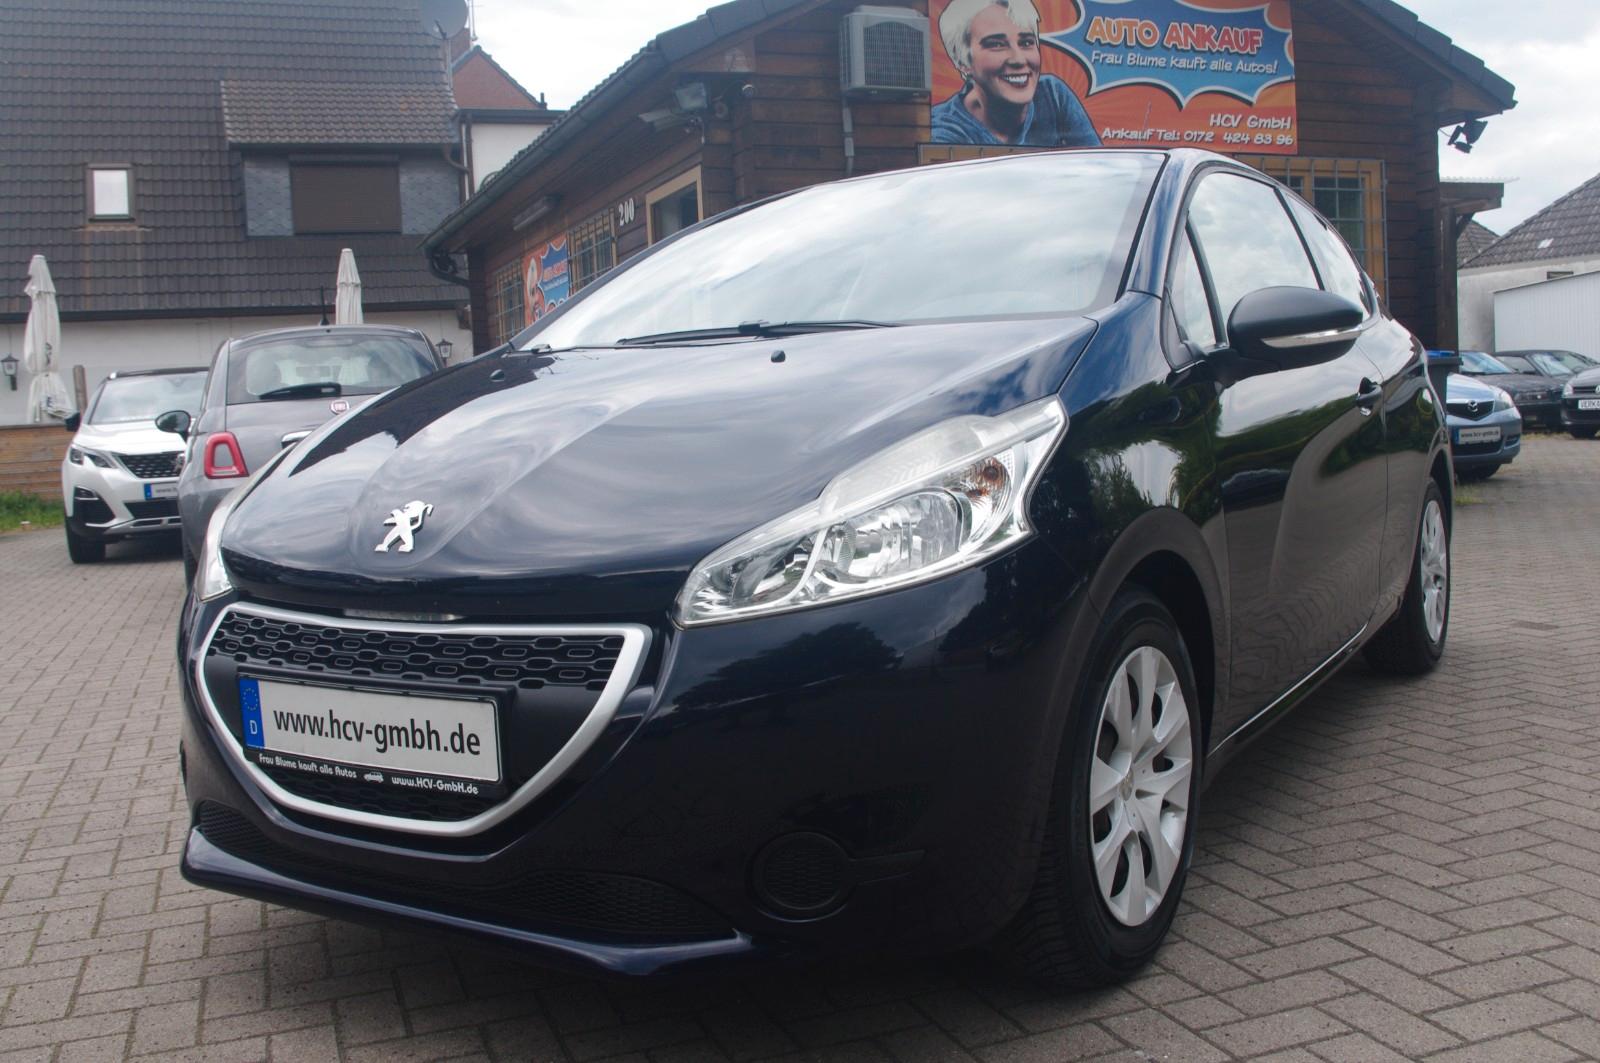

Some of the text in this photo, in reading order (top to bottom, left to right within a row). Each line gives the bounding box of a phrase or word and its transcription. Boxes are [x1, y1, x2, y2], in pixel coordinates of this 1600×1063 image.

[1086, 16, 1263, 55] AUTO ANKAUF
[1091, 50, 1279, 74] Frau Blume kauft alle Autos!
[1209, 113, 1292, 130] HCV GmbH
[1101, 127, 1154, 141] Ankauf
[1183, 130, 1215, 143] 0172
[1223, 131, 1251, 145] 424
[1253, 132, 1273, 145] 83
[1275, 133, 1294, 146] 96
[618, 198, 635, 227] 200
[249, 719, 258, 735] D
[273, 709, 481, 756] www.hcv-gmbh.de
[258, 753, 479, 795] Frau Blume kauft alle Autos www.HCV-GmbH.de
